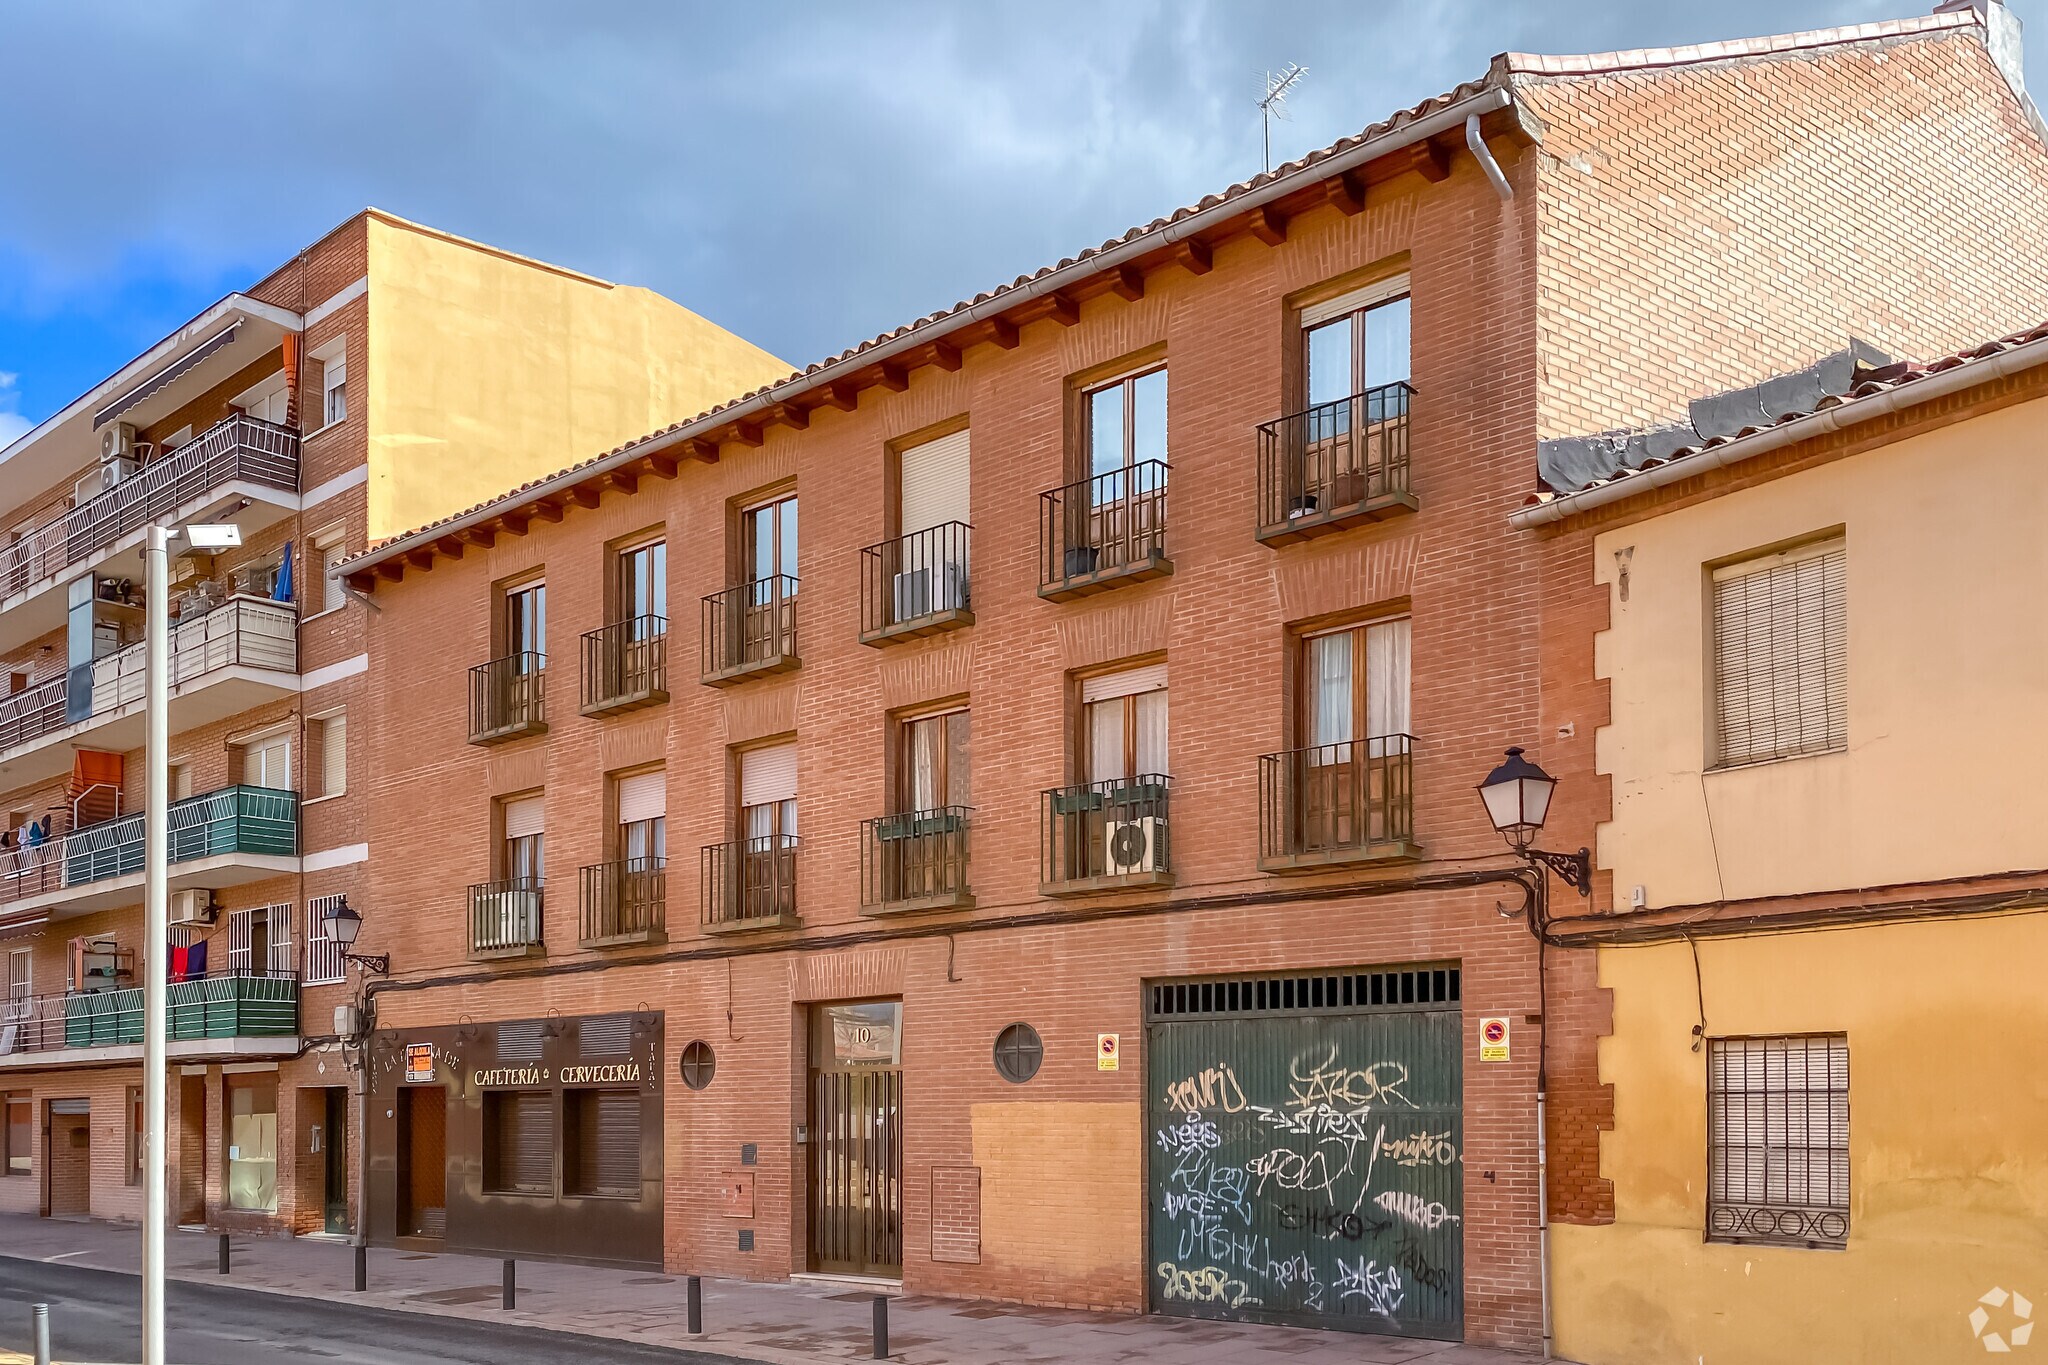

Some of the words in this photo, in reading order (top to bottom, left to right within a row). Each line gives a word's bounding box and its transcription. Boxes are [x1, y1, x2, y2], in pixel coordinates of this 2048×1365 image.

[856, 1027, 871, 1043] 10
[474, 1062, 540, 1086] CAFETERÍA
[560, 1057, 640, 1083] CERVECERÍA
